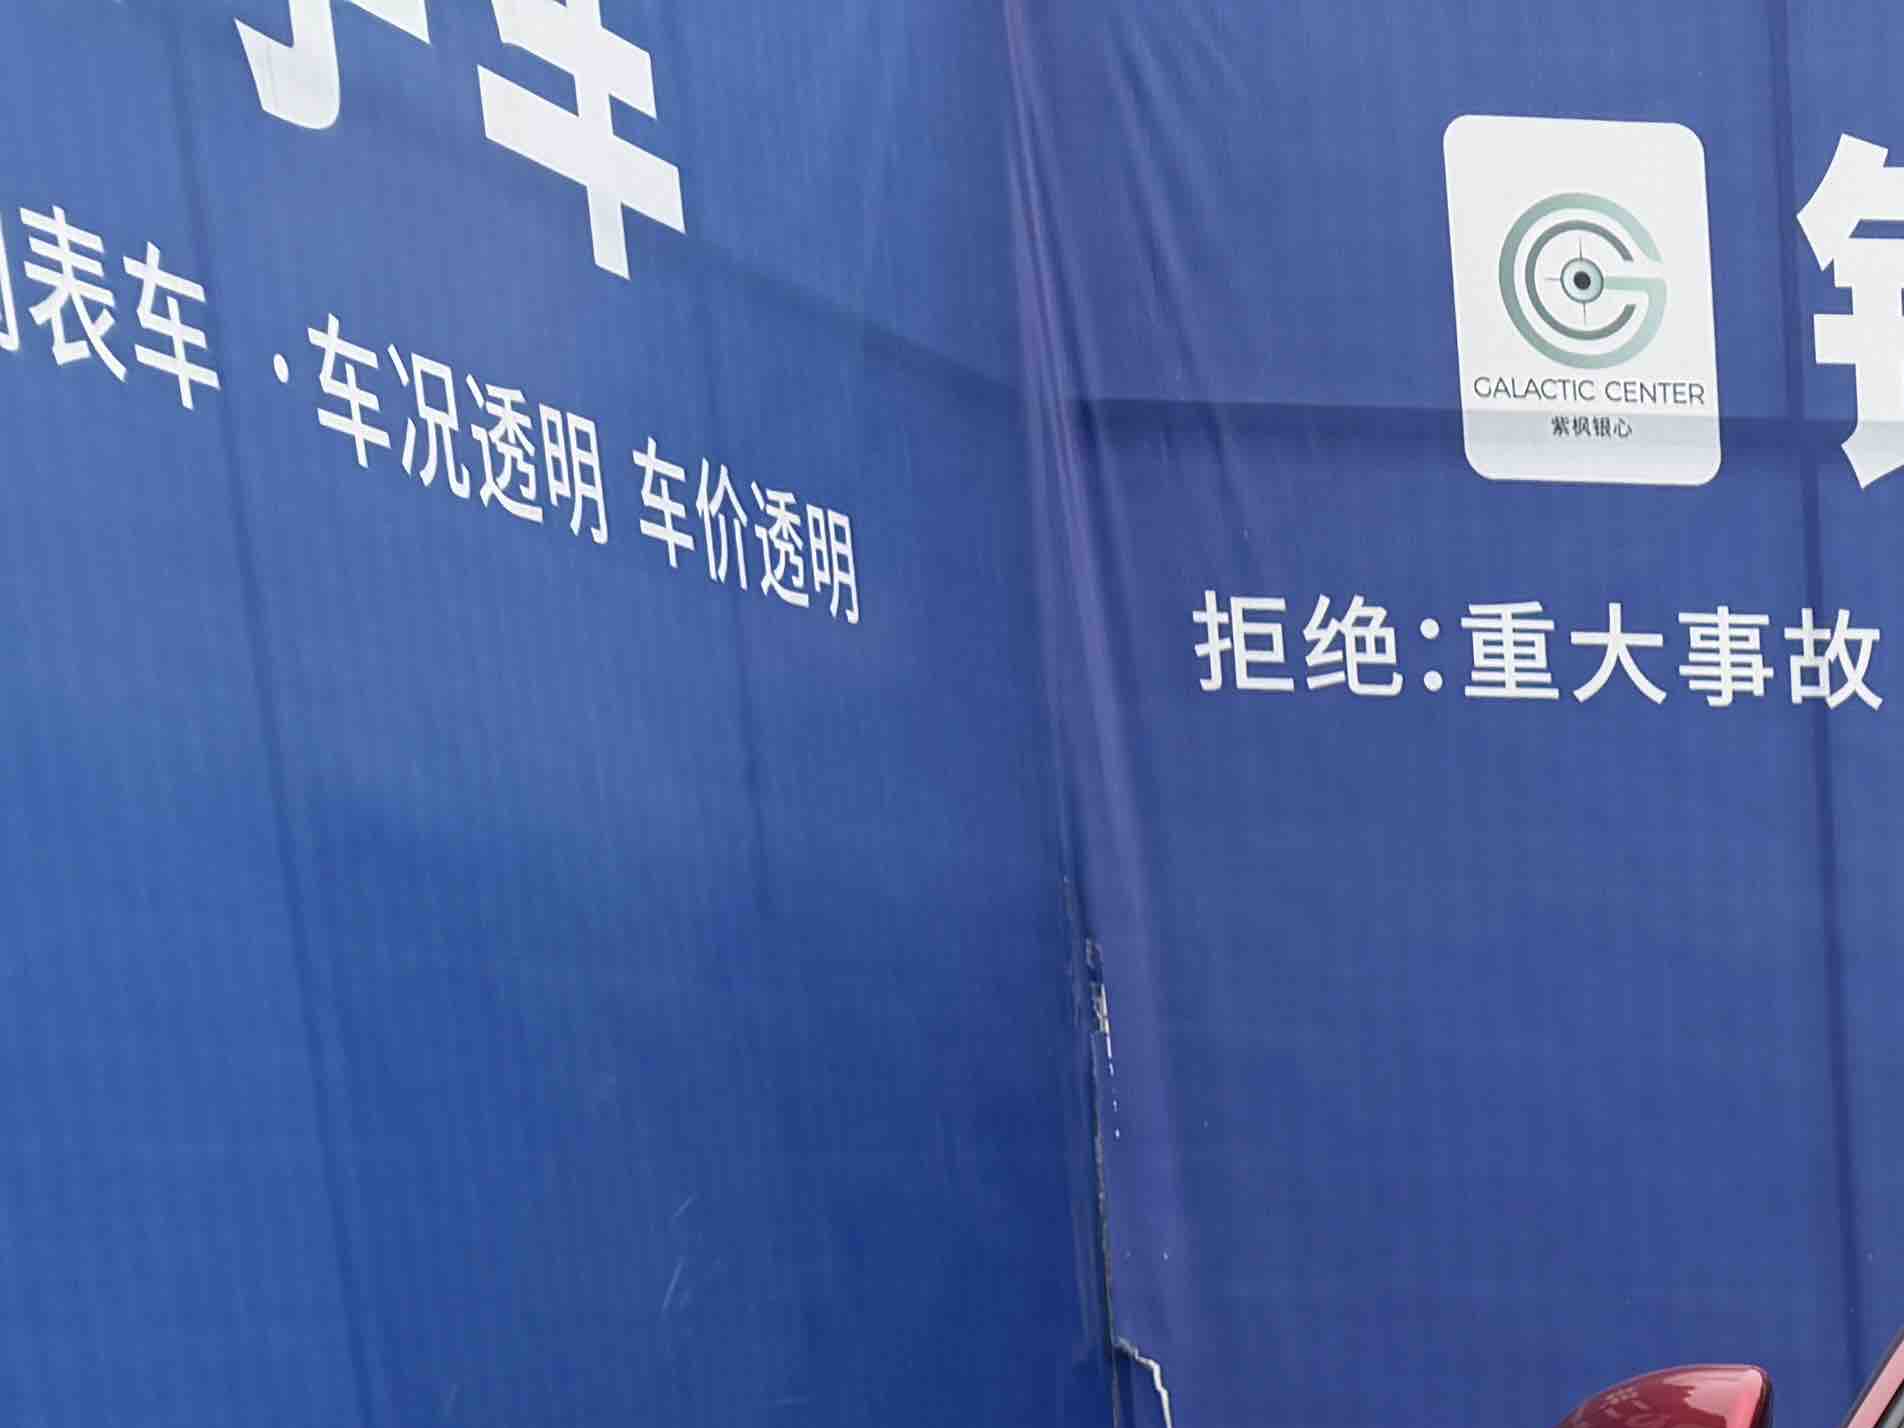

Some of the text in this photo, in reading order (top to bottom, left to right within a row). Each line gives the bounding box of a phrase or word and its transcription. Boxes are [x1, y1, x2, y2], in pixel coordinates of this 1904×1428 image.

[1473, 376, 1705, 405] GALACTIC CENTER
[0, 206, 220, 410] 表车
[632, 437, 859, 624] 车价透明
[1551, 416, 1633, 438] 紫枫银心
